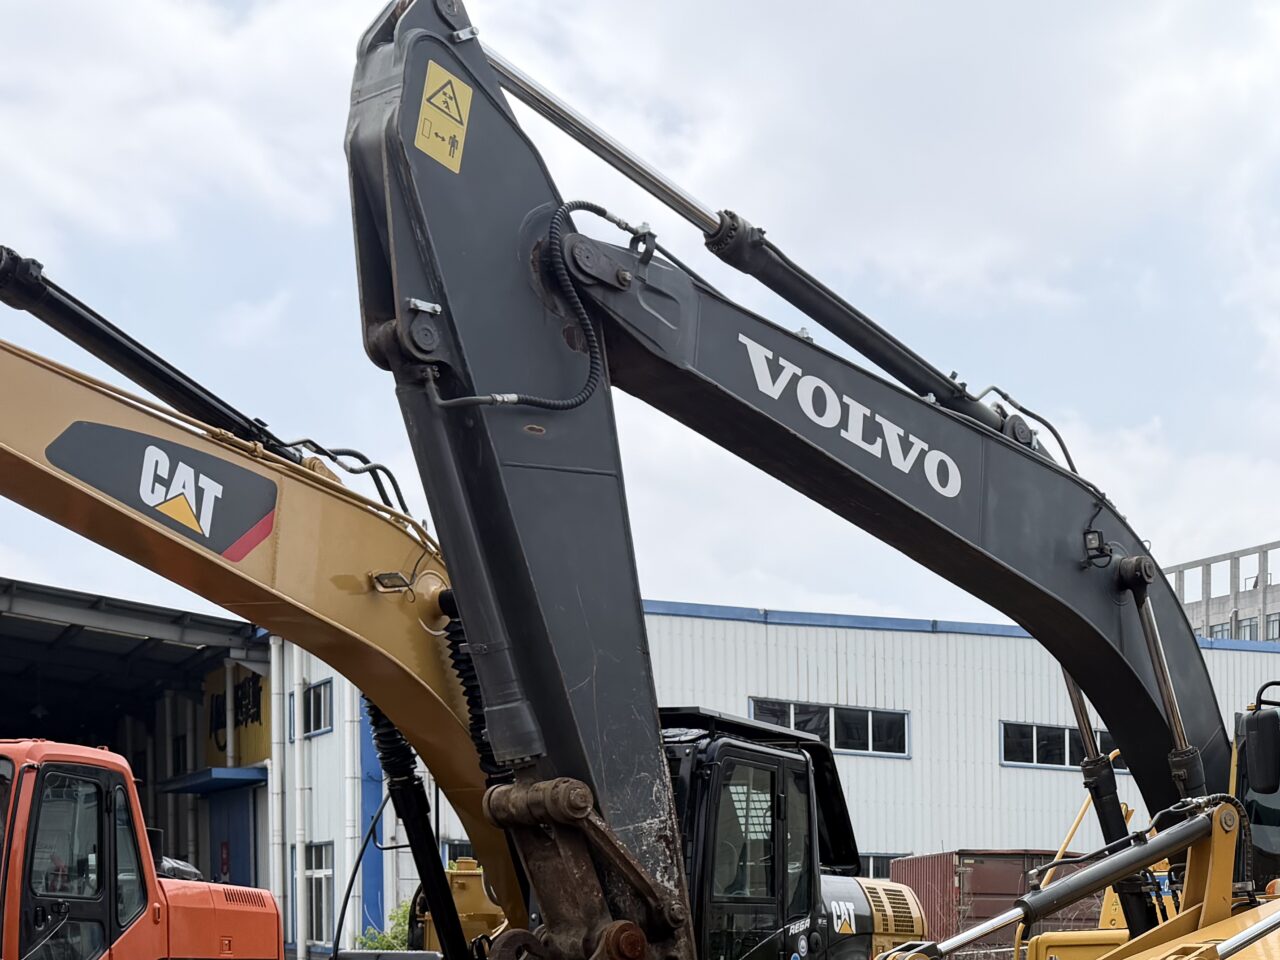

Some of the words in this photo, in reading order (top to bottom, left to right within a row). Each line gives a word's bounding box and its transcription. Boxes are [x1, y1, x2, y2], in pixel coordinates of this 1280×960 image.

[738, 332, 962, 498] VOLVO
[139, 445, 224, 538] CAT
[831, 901, 857, 934] CAT
